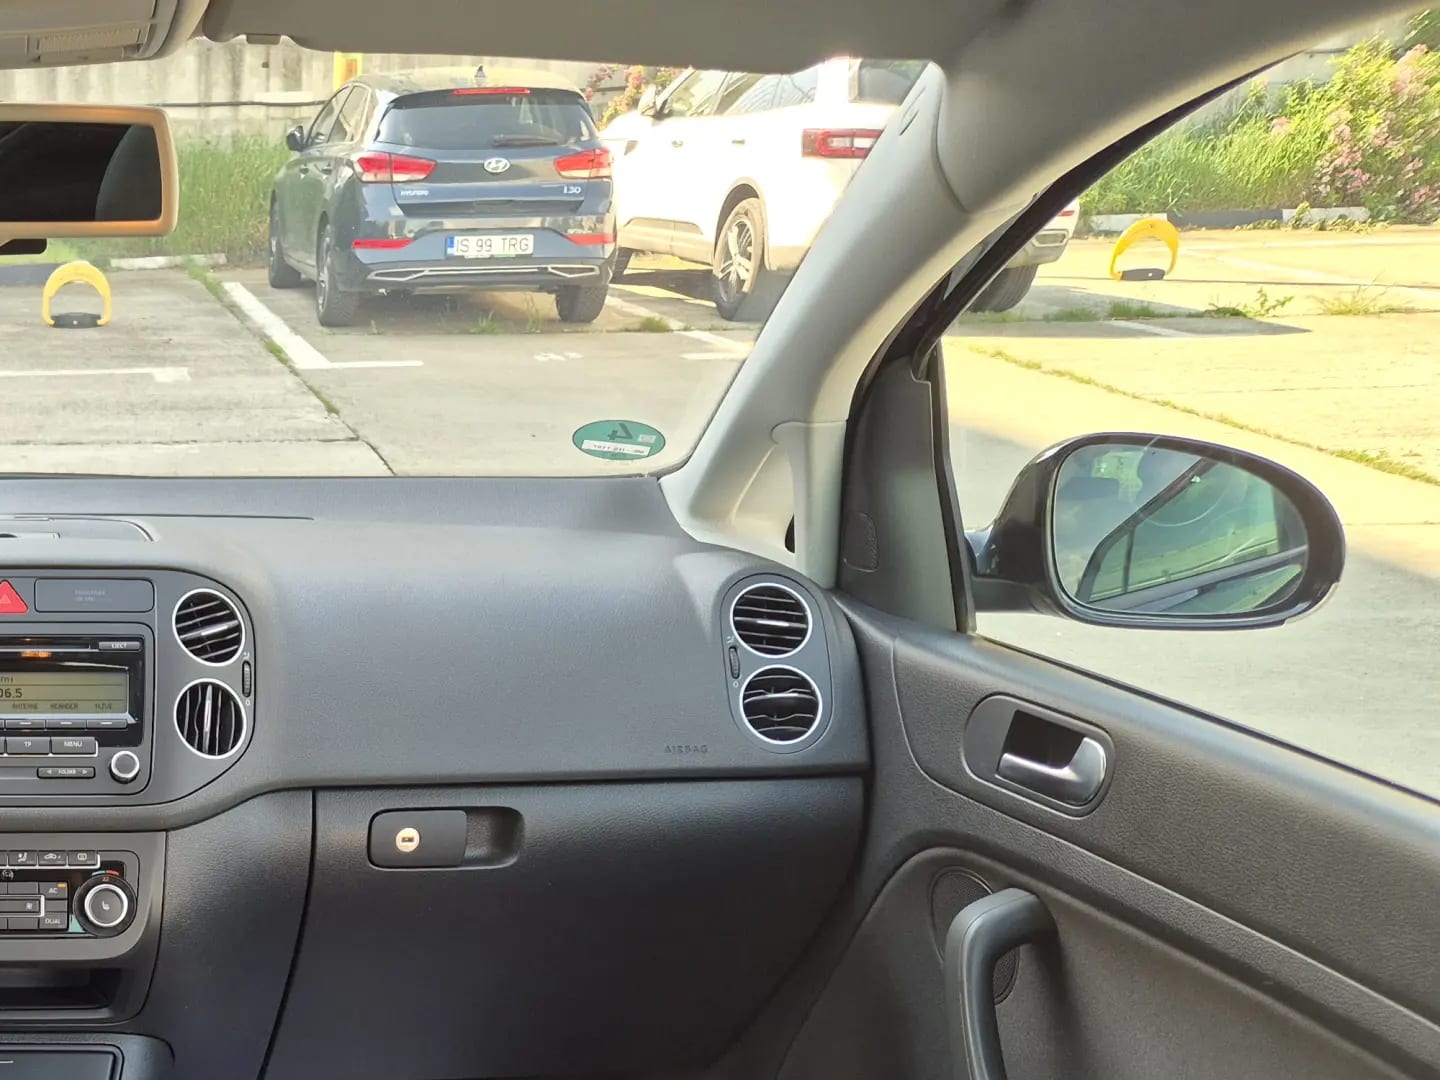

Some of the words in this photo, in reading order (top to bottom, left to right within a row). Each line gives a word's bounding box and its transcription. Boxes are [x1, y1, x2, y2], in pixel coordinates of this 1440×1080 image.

[456, 238, 470, 252] IS
[476, 238, 492, 252] 99
[501, 237, 529, 251] TRG
[664, 744, 708, 753] AIRBAG
